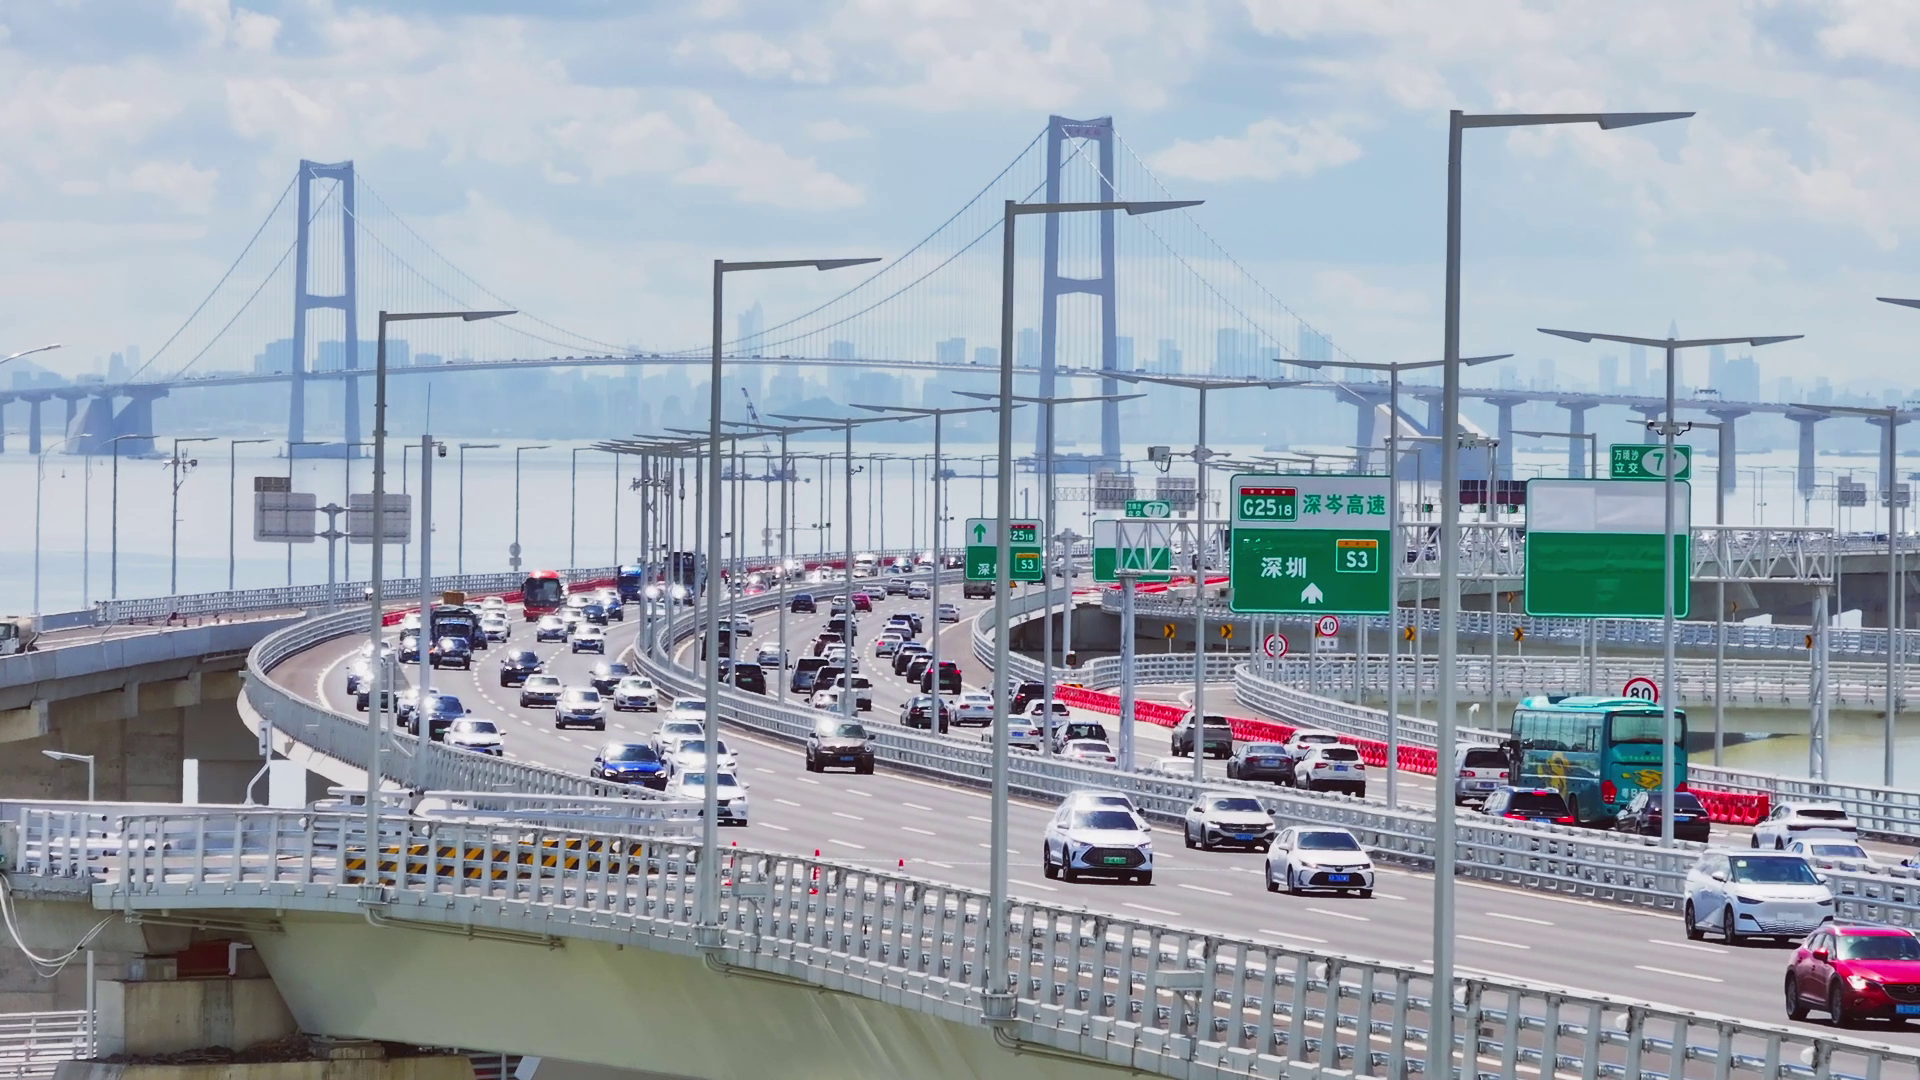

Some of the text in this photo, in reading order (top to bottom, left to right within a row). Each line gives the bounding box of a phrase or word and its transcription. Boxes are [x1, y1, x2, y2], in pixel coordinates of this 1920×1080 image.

[1614, 450, 1639, 461] 万顷沙
[1614, 463, 1639, 473] 立交
[1149, 505, 1163, 515] 77
[1243, 498, 1293, 516] G2518
[1302, 494, 1386, 515] 深岑高速
[1010, 530, 1034, 541] 2518
[1021, 559, 1034, 570] S3
[1346, 551, 1368, 568] S3
[1260, 556, 1307, 578] 深圳
[1322, 621, 1335, 631] 40
[1630, 687, 1651, 700] 80
